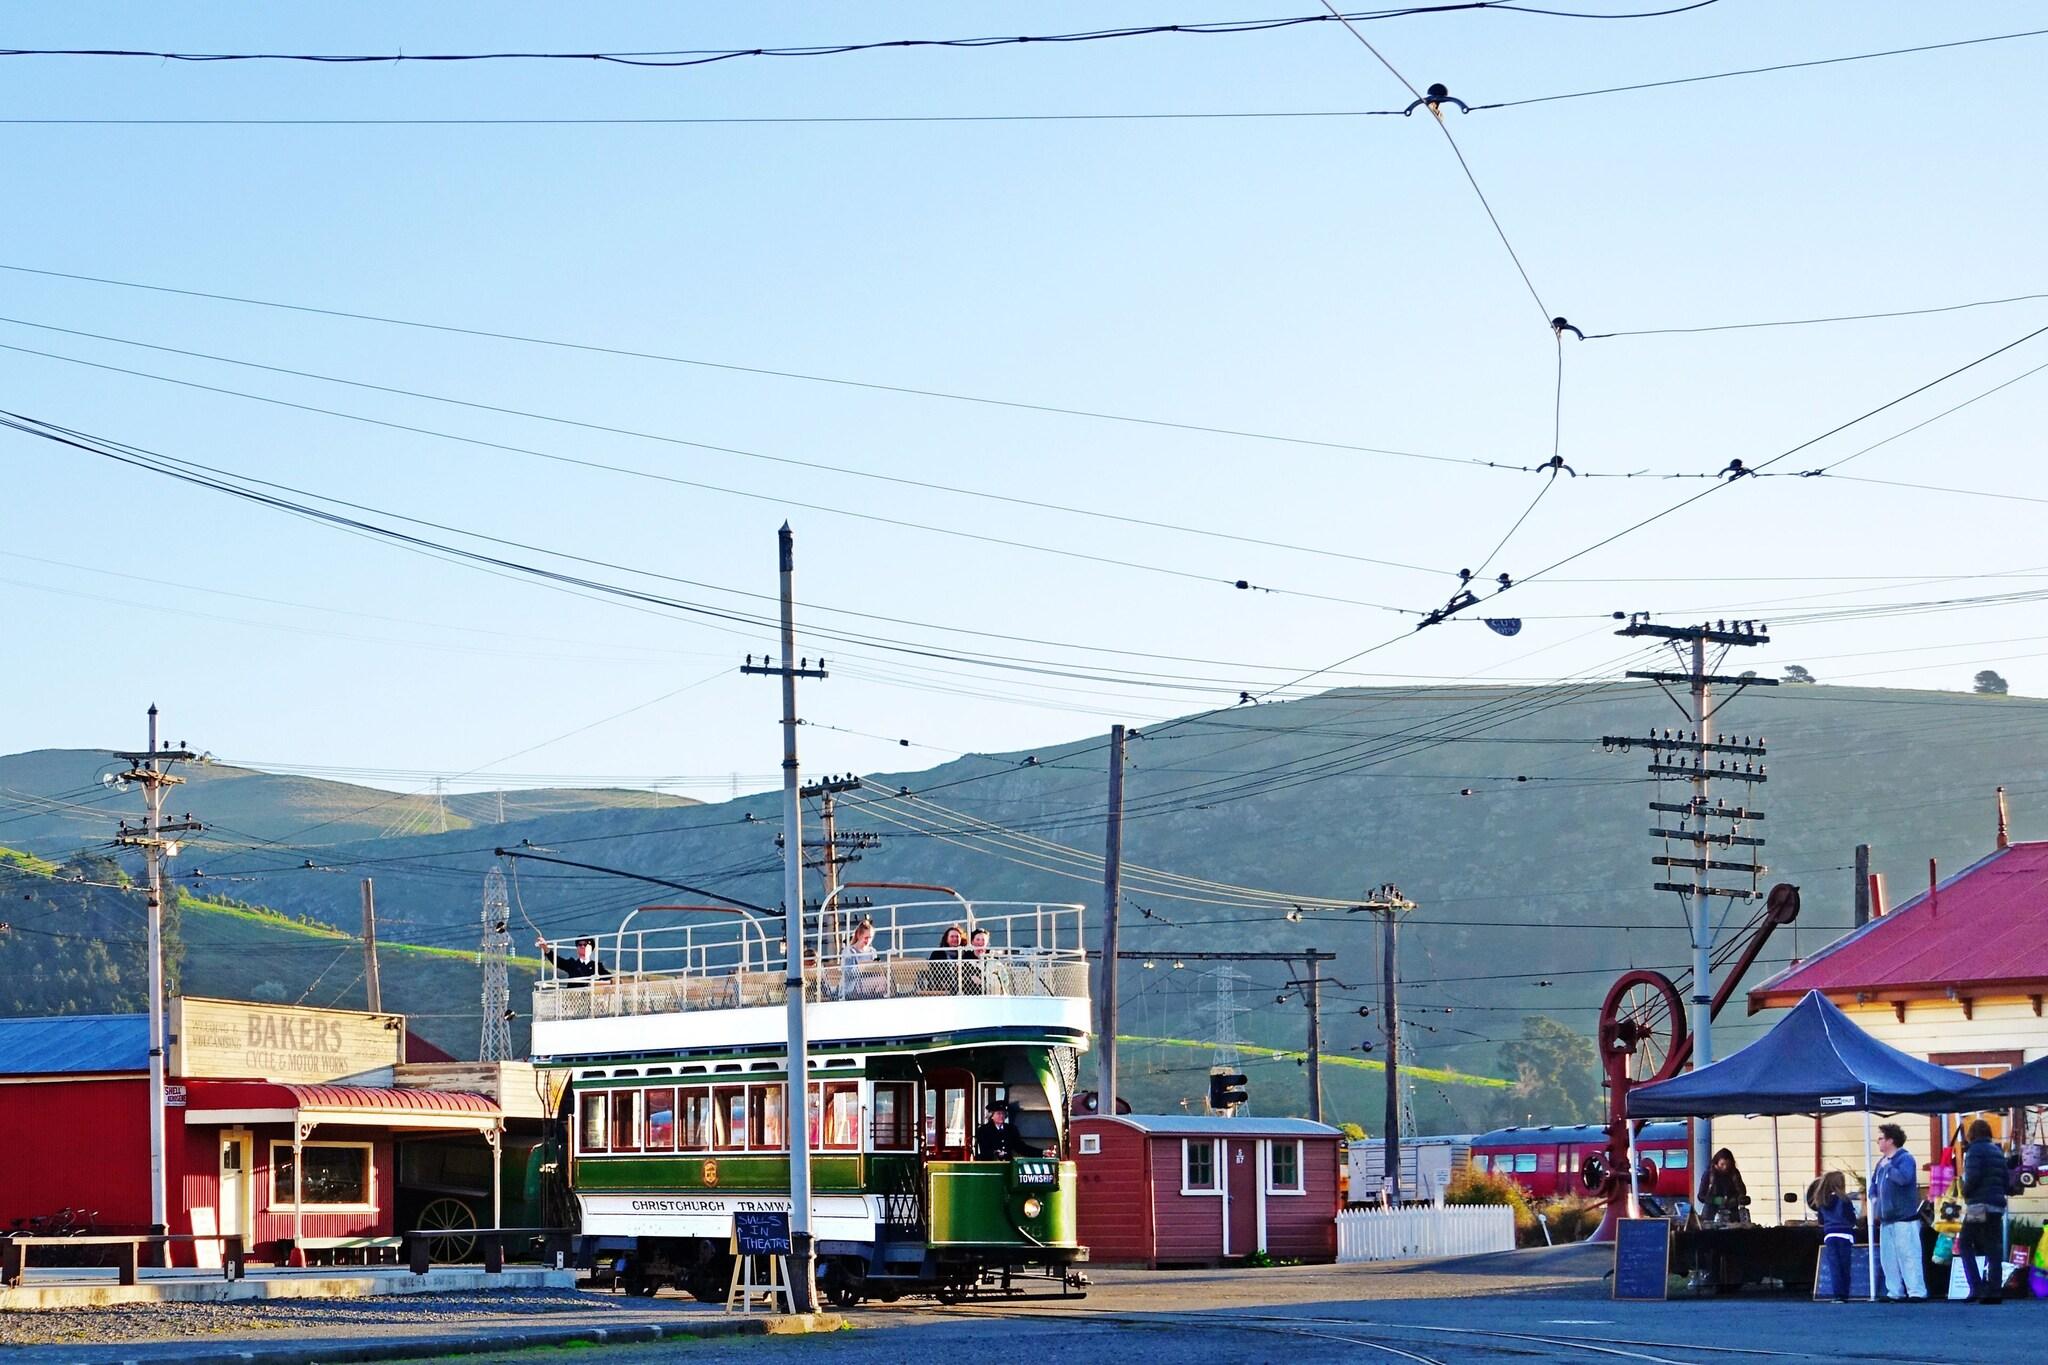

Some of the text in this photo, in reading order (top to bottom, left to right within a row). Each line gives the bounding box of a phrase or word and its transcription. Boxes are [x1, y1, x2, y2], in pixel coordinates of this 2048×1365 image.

[247, 1013, 343, 1053] BAKERS
[246, 1049, 350, 1074] CYCLE & MOTOR WORKS
[1019, 1174, 1054, 1183] TOWNSHIP
[632, 1200, 793, 1212] CHRISTCHURCH TRAMWA
[750, 1225, 769, 1236] IN
[741, 1237, 790, 1251] THEATRE
